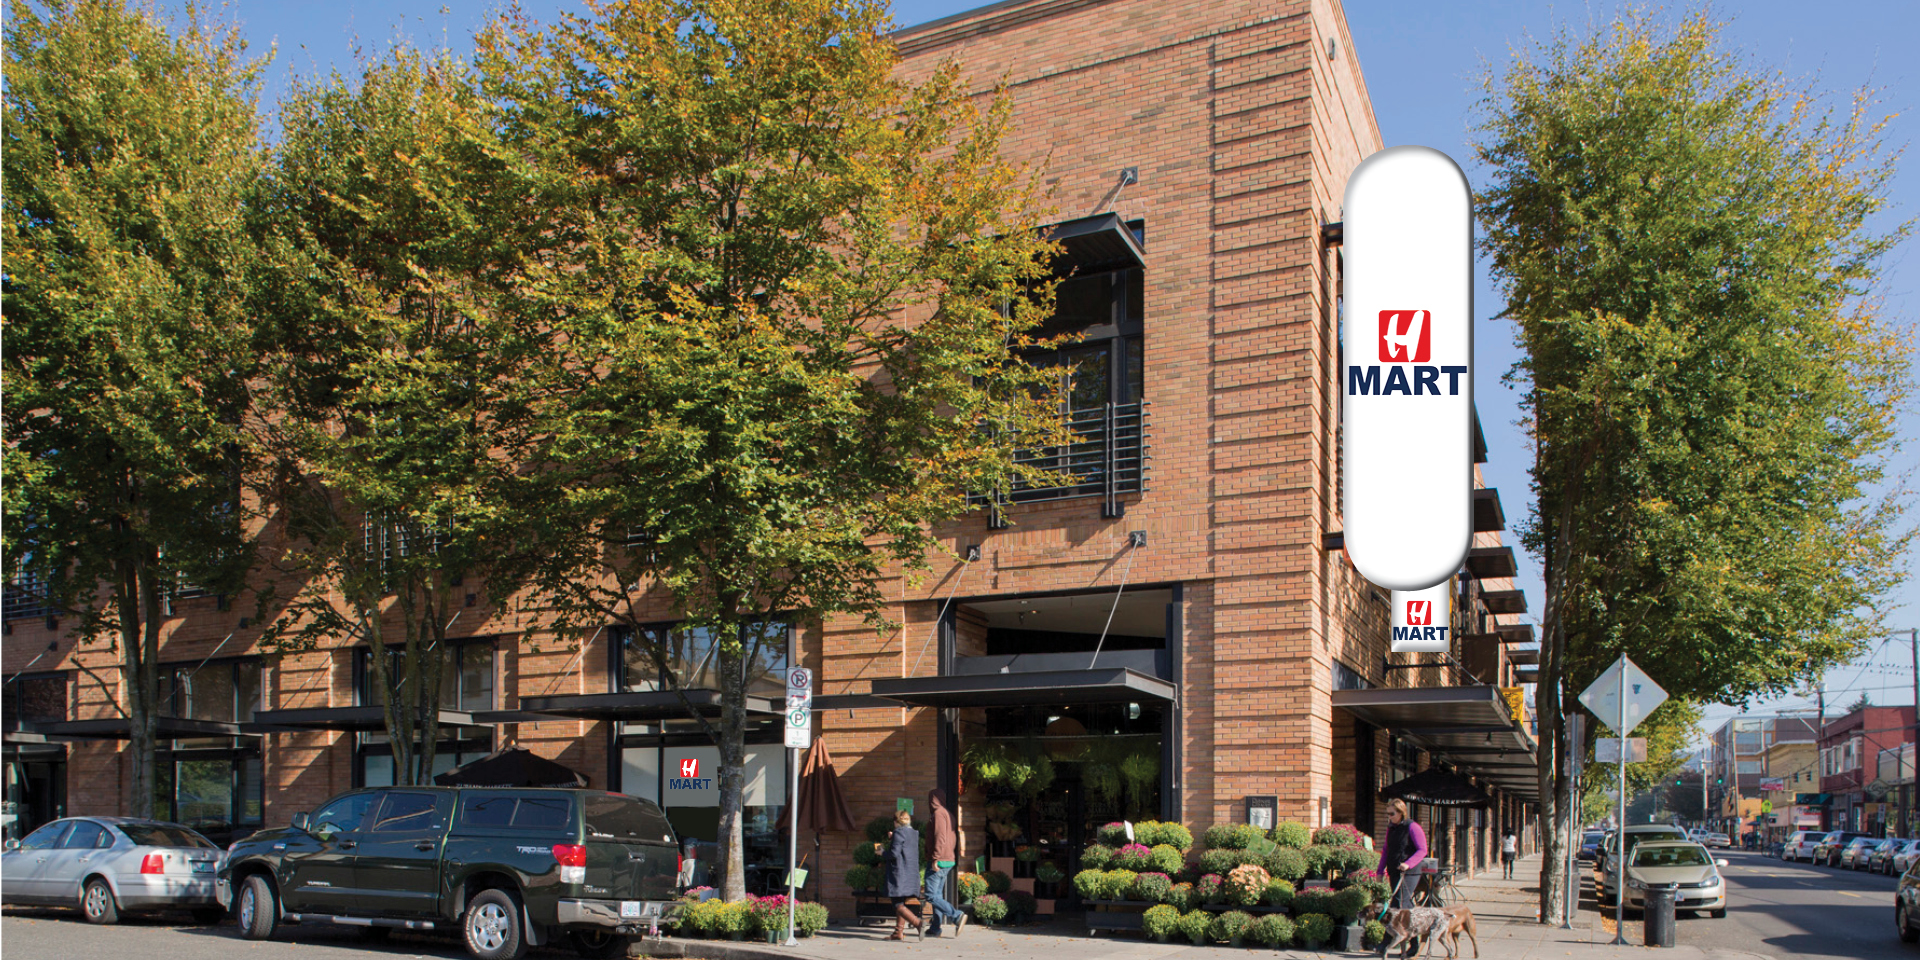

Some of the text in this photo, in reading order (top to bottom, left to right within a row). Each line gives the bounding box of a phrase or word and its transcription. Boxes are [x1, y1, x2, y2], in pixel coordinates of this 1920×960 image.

[1383, 310, 1424, 362] H
[1349, 366, 1467, 395] MART
[1409, 601, 1428, 625] H
[1393, 627, 1448, 640] MART
[682, 759, 696, 777] H
[670, 779, 711, 789] MART
